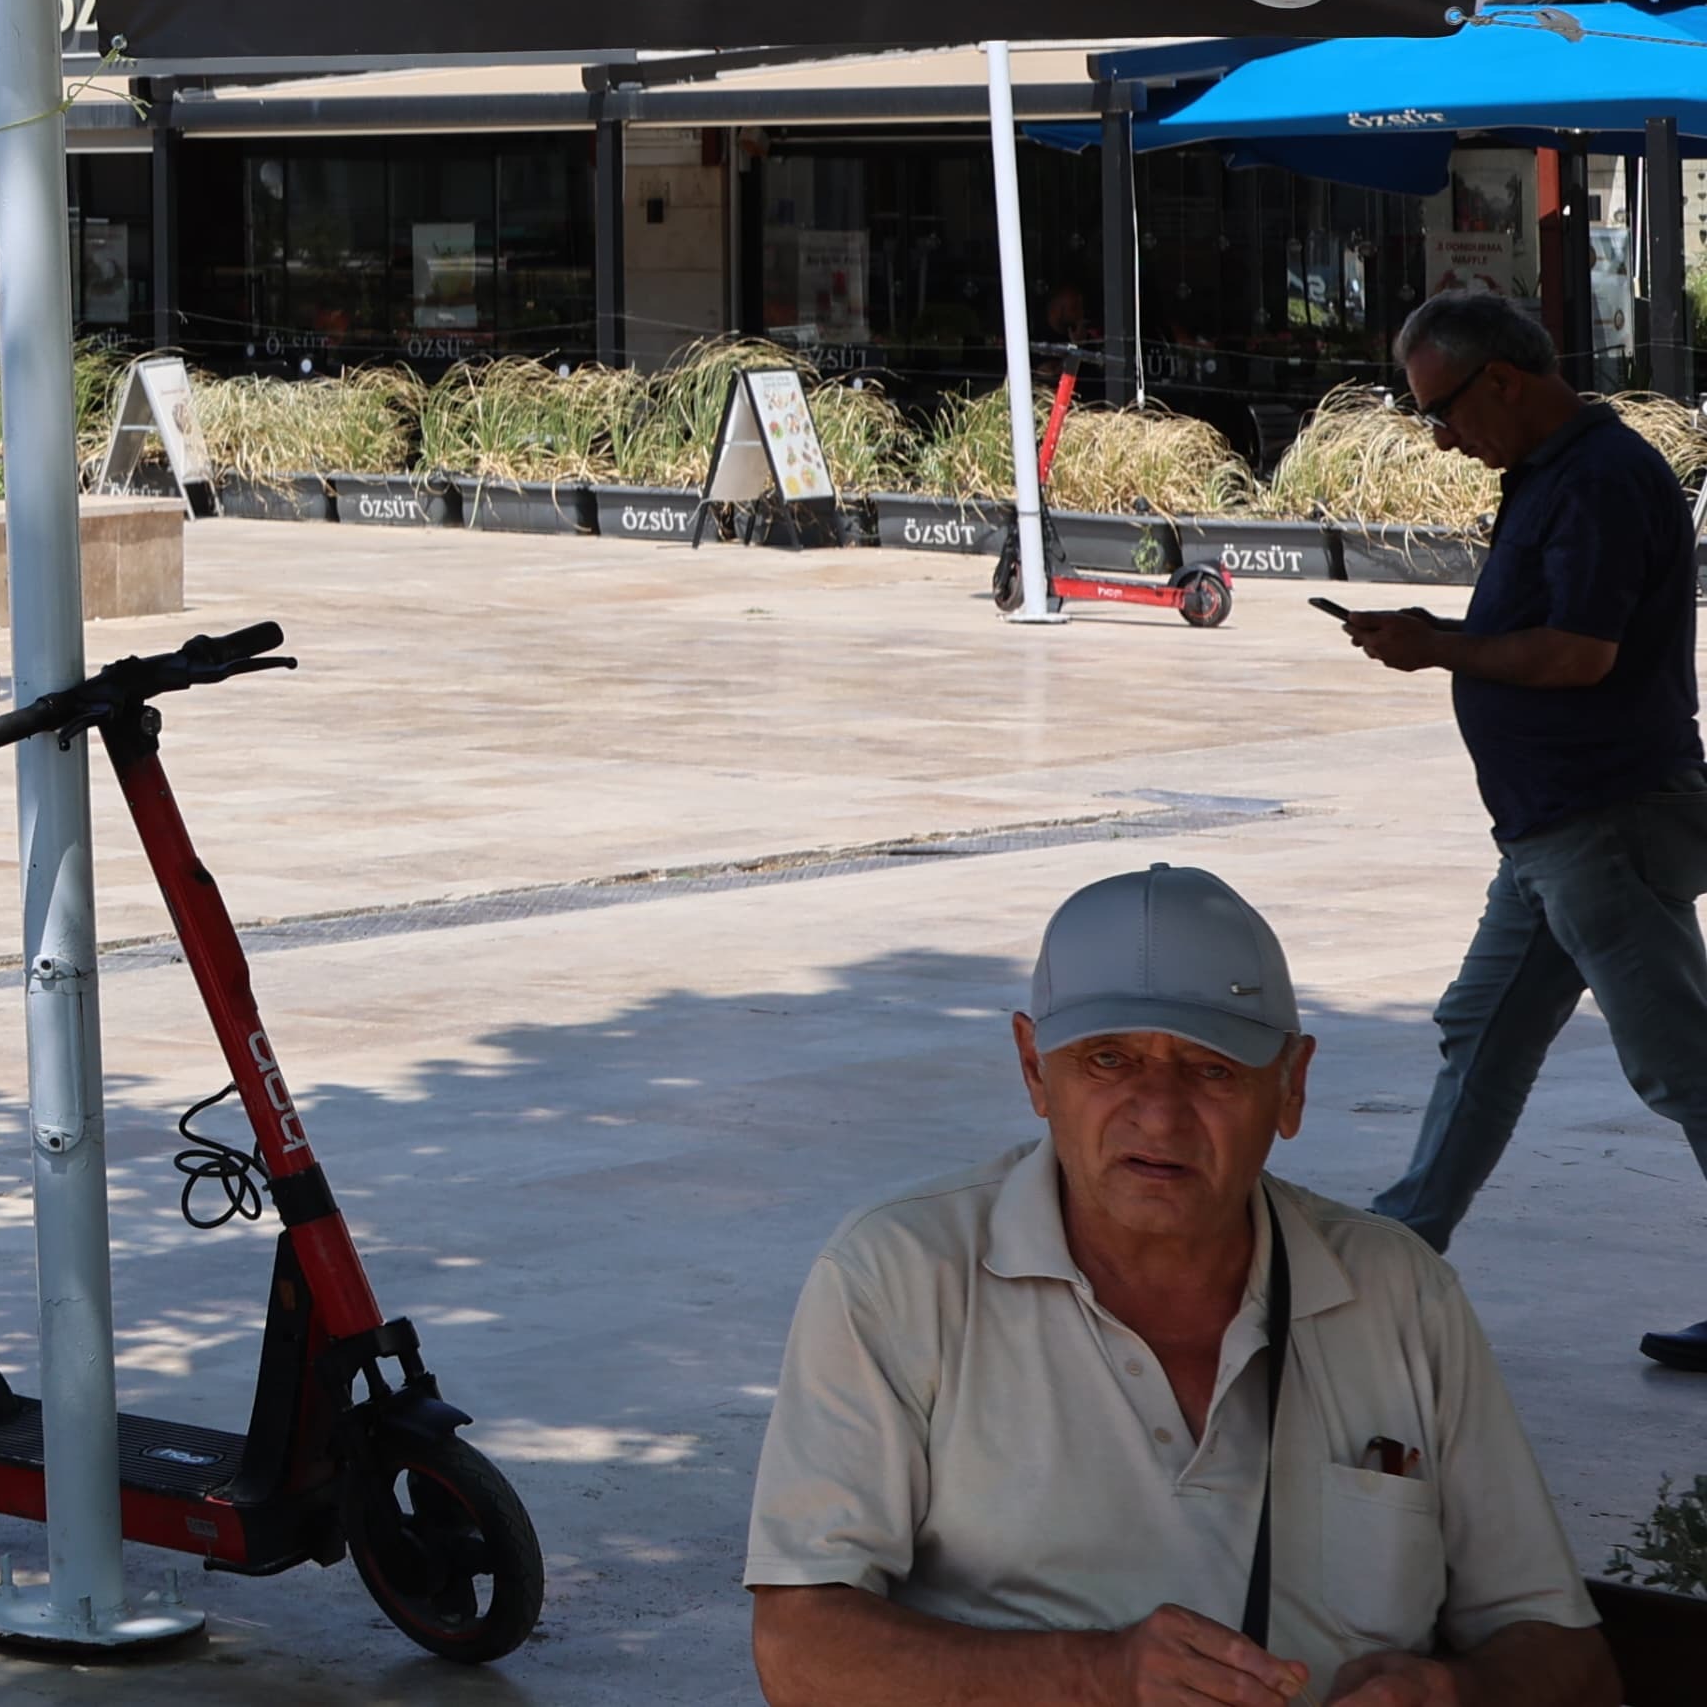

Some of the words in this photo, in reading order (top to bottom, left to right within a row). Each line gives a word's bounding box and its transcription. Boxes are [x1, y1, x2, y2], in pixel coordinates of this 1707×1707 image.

[359, 494, 419, 520] ÖZSÜT
[621, 505, 688, 533] ÖZSÜT
[904, 517, 976, 545] ÖZSÜT
[1221, 543, 1303, 573] ÖZSÜT
